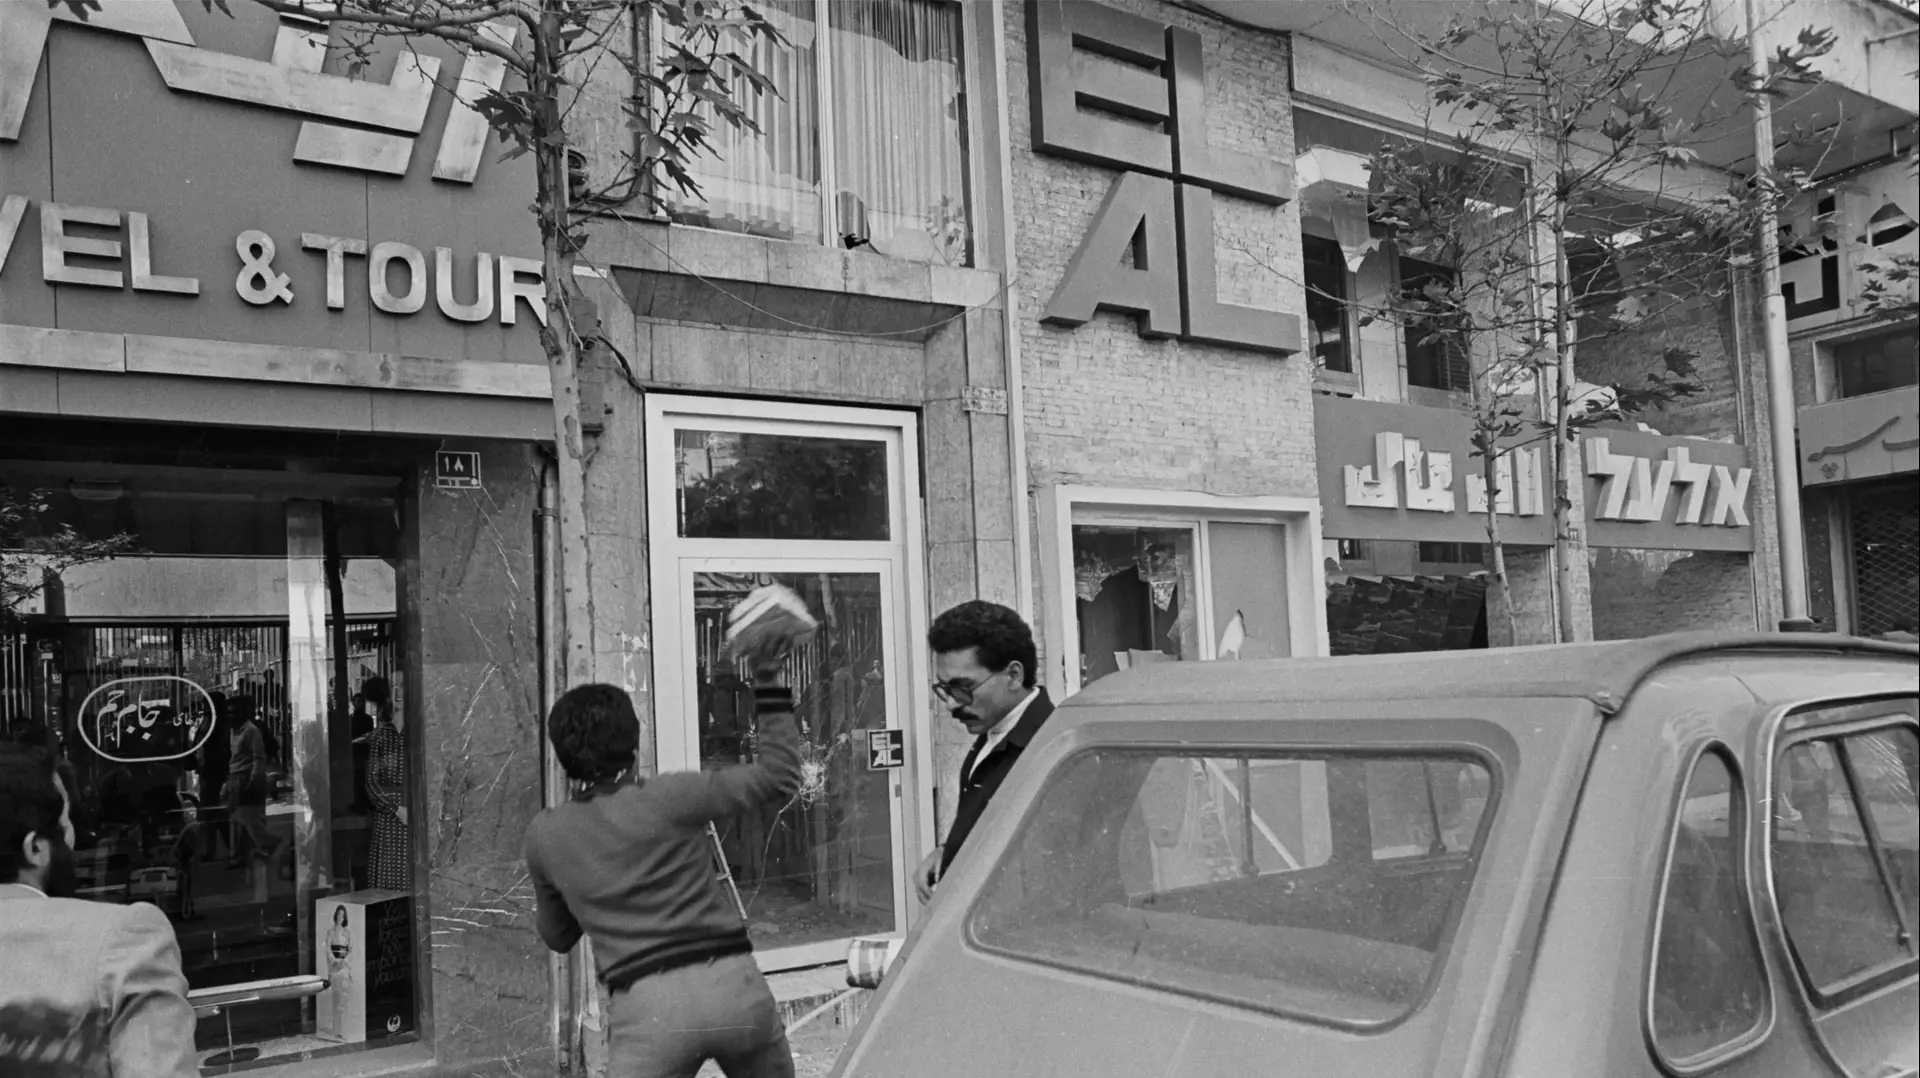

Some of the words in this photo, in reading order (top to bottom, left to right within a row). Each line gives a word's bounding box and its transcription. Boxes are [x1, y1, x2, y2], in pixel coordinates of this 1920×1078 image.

[1025, 0, 1292, 206] EL
[235, 229, 294, 306] &
[301, 231, 547, 328] TOUR
[1040, 169, 1302, 356] AL
[444, 455, 465, 473] ۱۸
[871, 733, 901, 751] EL
[872, 750, 902, 767] AL
